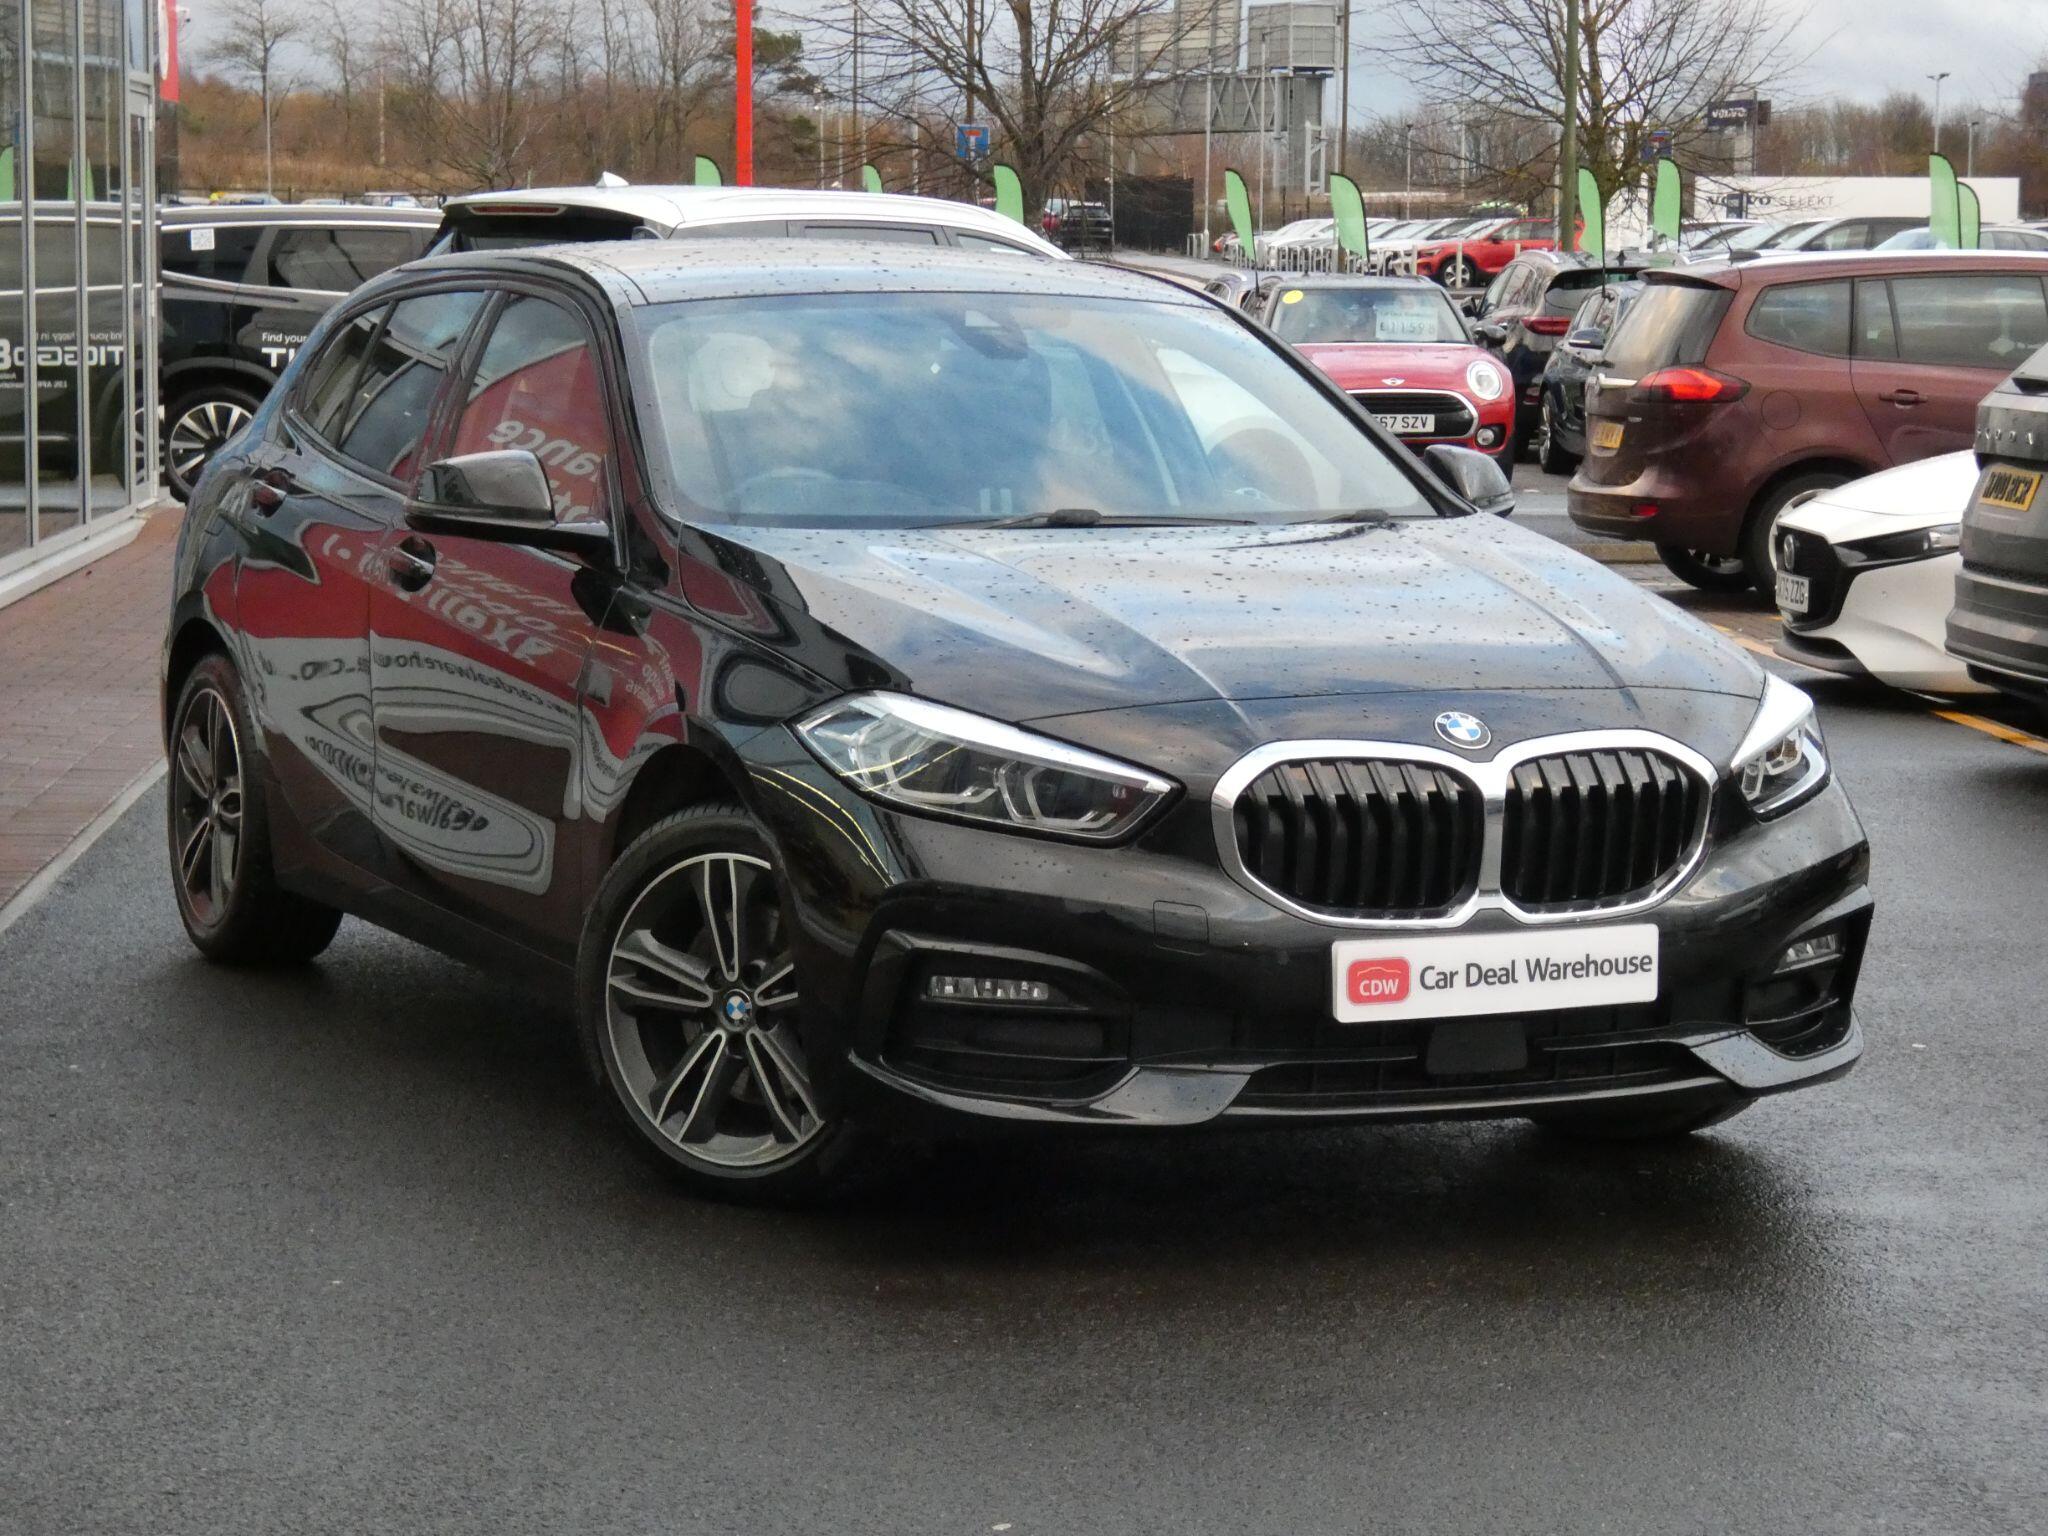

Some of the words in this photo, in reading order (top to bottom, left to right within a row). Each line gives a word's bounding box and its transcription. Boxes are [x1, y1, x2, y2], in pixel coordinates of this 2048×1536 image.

[1706, 195, 1773, 207] VOVO
[1780, 195, 1835, 207] SELEKT
[262, 331, 283, 343] Find
[284, 334, 307, 345] your
[1401, 415, 1428, 429] SZV
[1419, 965, 1459, 990] Car
[1465, 962, 1519, 988] Deal
[1525, 953, 1653, 983] Warehouse
[1359, 978, 1400, 997] CDW
